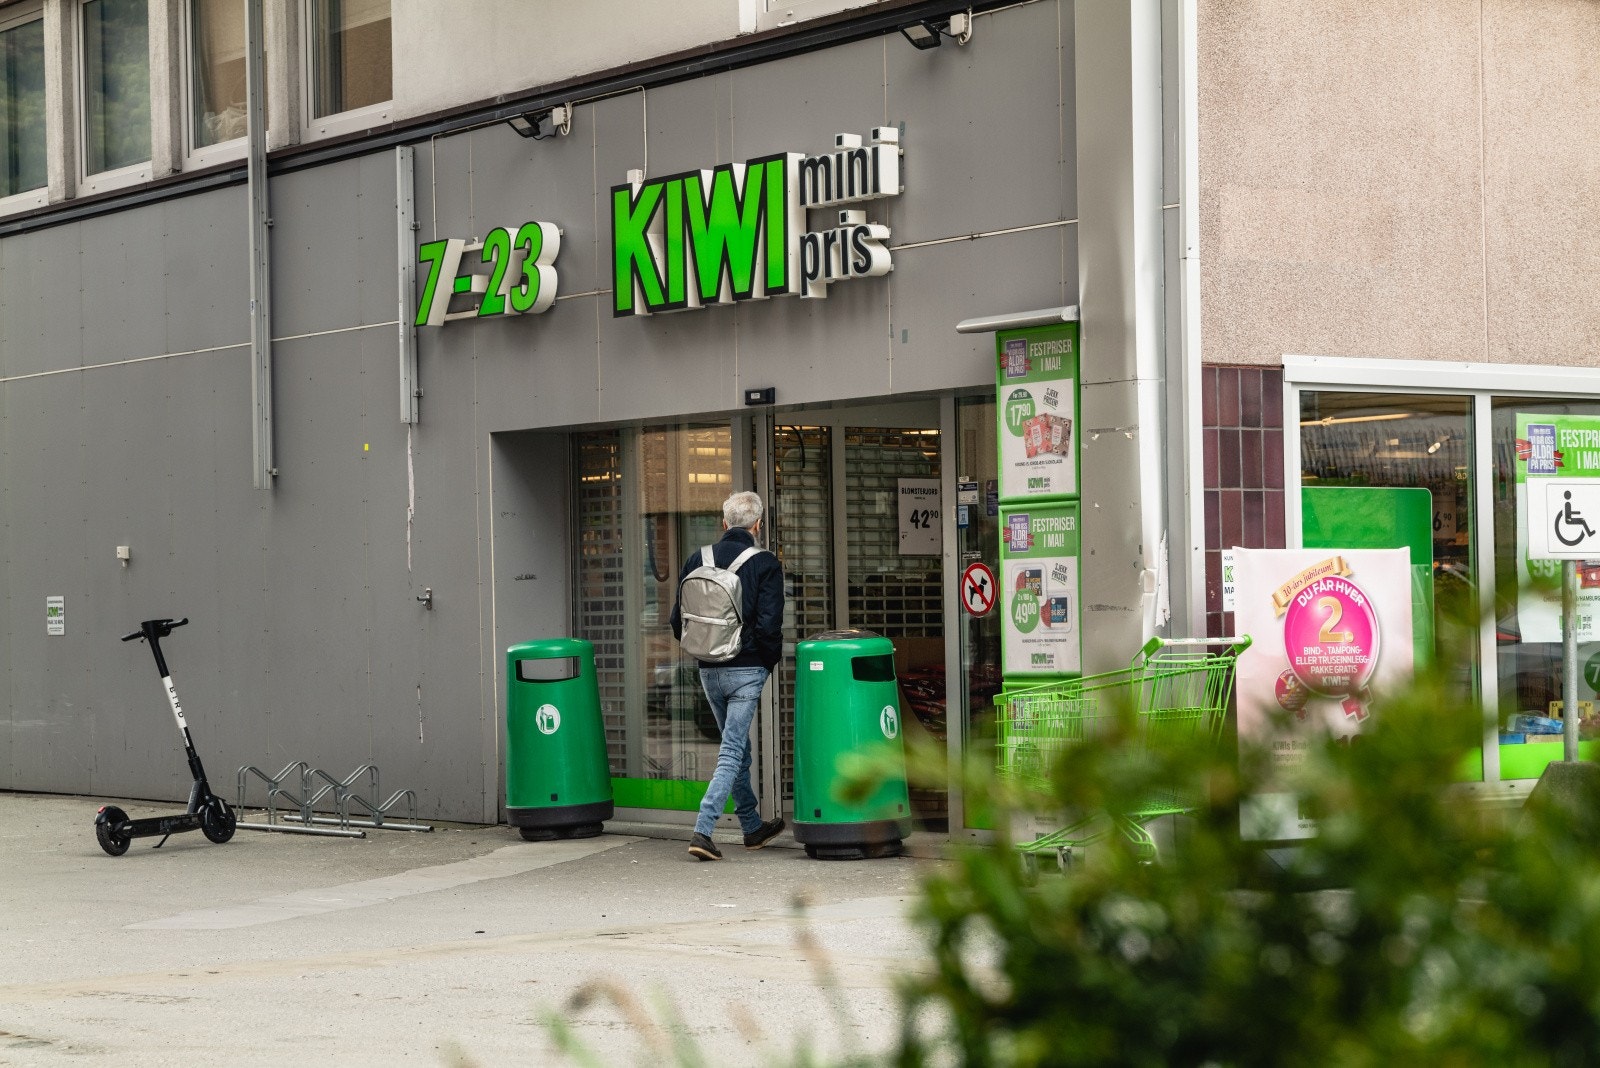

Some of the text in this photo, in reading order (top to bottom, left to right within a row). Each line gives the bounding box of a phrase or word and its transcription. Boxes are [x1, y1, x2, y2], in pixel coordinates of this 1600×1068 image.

[610, 127, 893, 317] KIWI mini
[800, 210, 886, 298] pris
[414, 221, 554, 327] 7-23
[1030, 339, 1072, 356] FESTPRISER
[1045, 356, 1062, 370] MAI!
[1532, 445, 1554, 459] ALDRI
[1033, 516, 1075, 532] FESTPRISER
[1048, 533, 1064, 547] MAI!
[1303, 562, 1334, 584] jubileum!
[1297, 587, 1314, 607] DU
[1335, 581, 1365, 607] HVER
[1296, 657, 1317, 665] ELLER
[1310, 665, 1358, 674] PAKKE GRATIS
[1322, 676, 1341, 686] KIWI
[169, 686, 183, 718] BIRD
